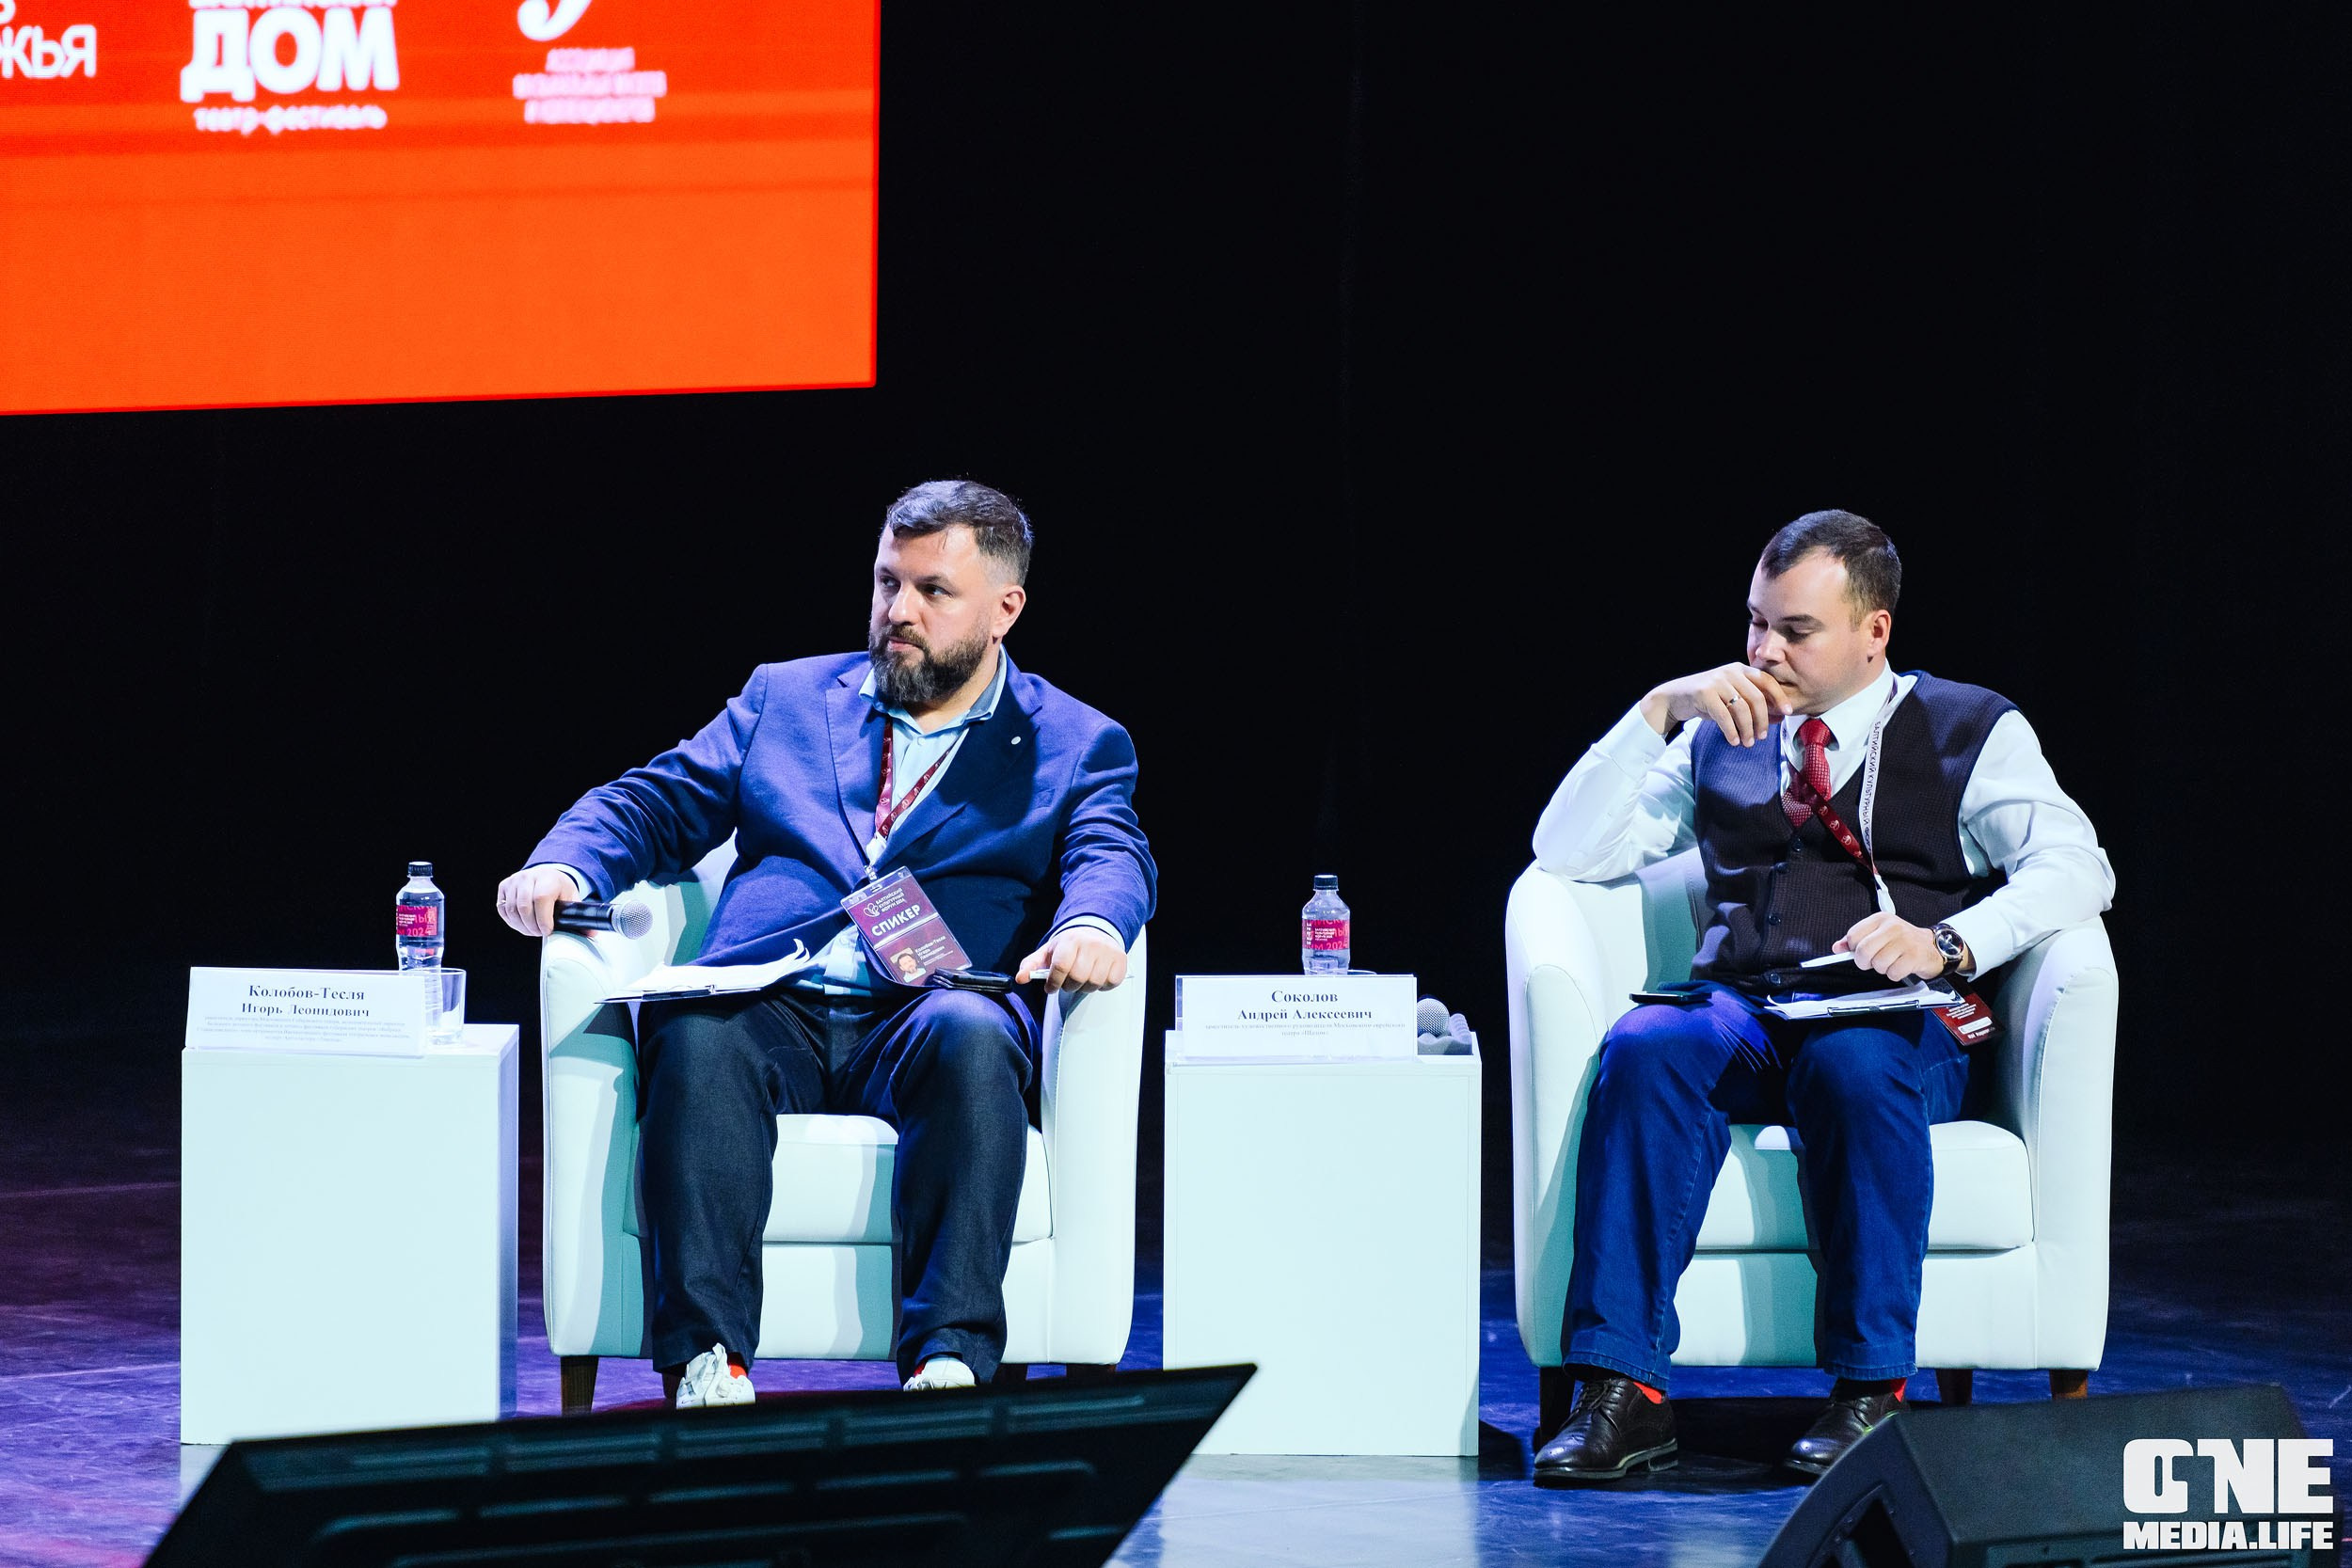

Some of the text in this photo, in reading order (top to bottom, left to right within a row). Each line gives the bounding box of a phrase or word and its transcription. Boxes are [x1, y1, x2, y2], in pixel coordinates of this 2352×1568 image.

[181, 8, 399, 102] ДОМ
[871, 904, 920, 936] СПИКЕР
[248, 985, 365, 1000] Колобов-Тесля
[1271, 990, 1339, 1003] Соколов
[241, 1003, 370, 1018] Игорь Леонидович
[1237, 1008, 1373, 1022] Андрей Алексеевич
